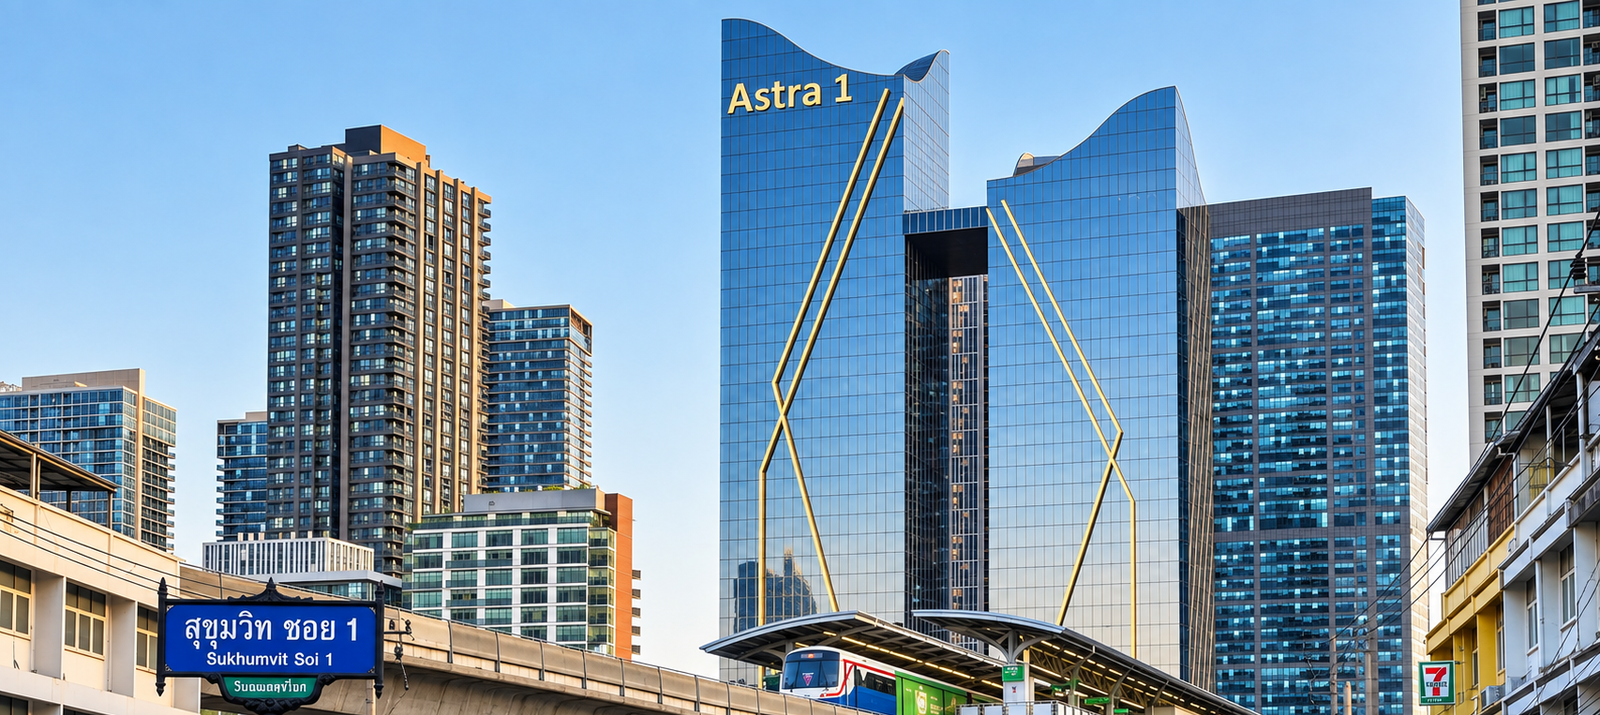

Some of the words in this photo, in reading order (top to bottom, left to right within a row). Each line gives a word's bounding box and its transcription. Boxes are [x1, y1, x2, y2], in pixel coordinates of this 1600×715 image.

[727, 80, 821, 114] Astra
[835, 73, 853, 103] 1
[185, 610, 272, 650] สุขุมวิท
[346, 617, 357, 642] 1
[206, 651, 289, 666] Sukhumvit
[294, 652, 319, 666] Soi
[325, 652, 332, 667] 1
